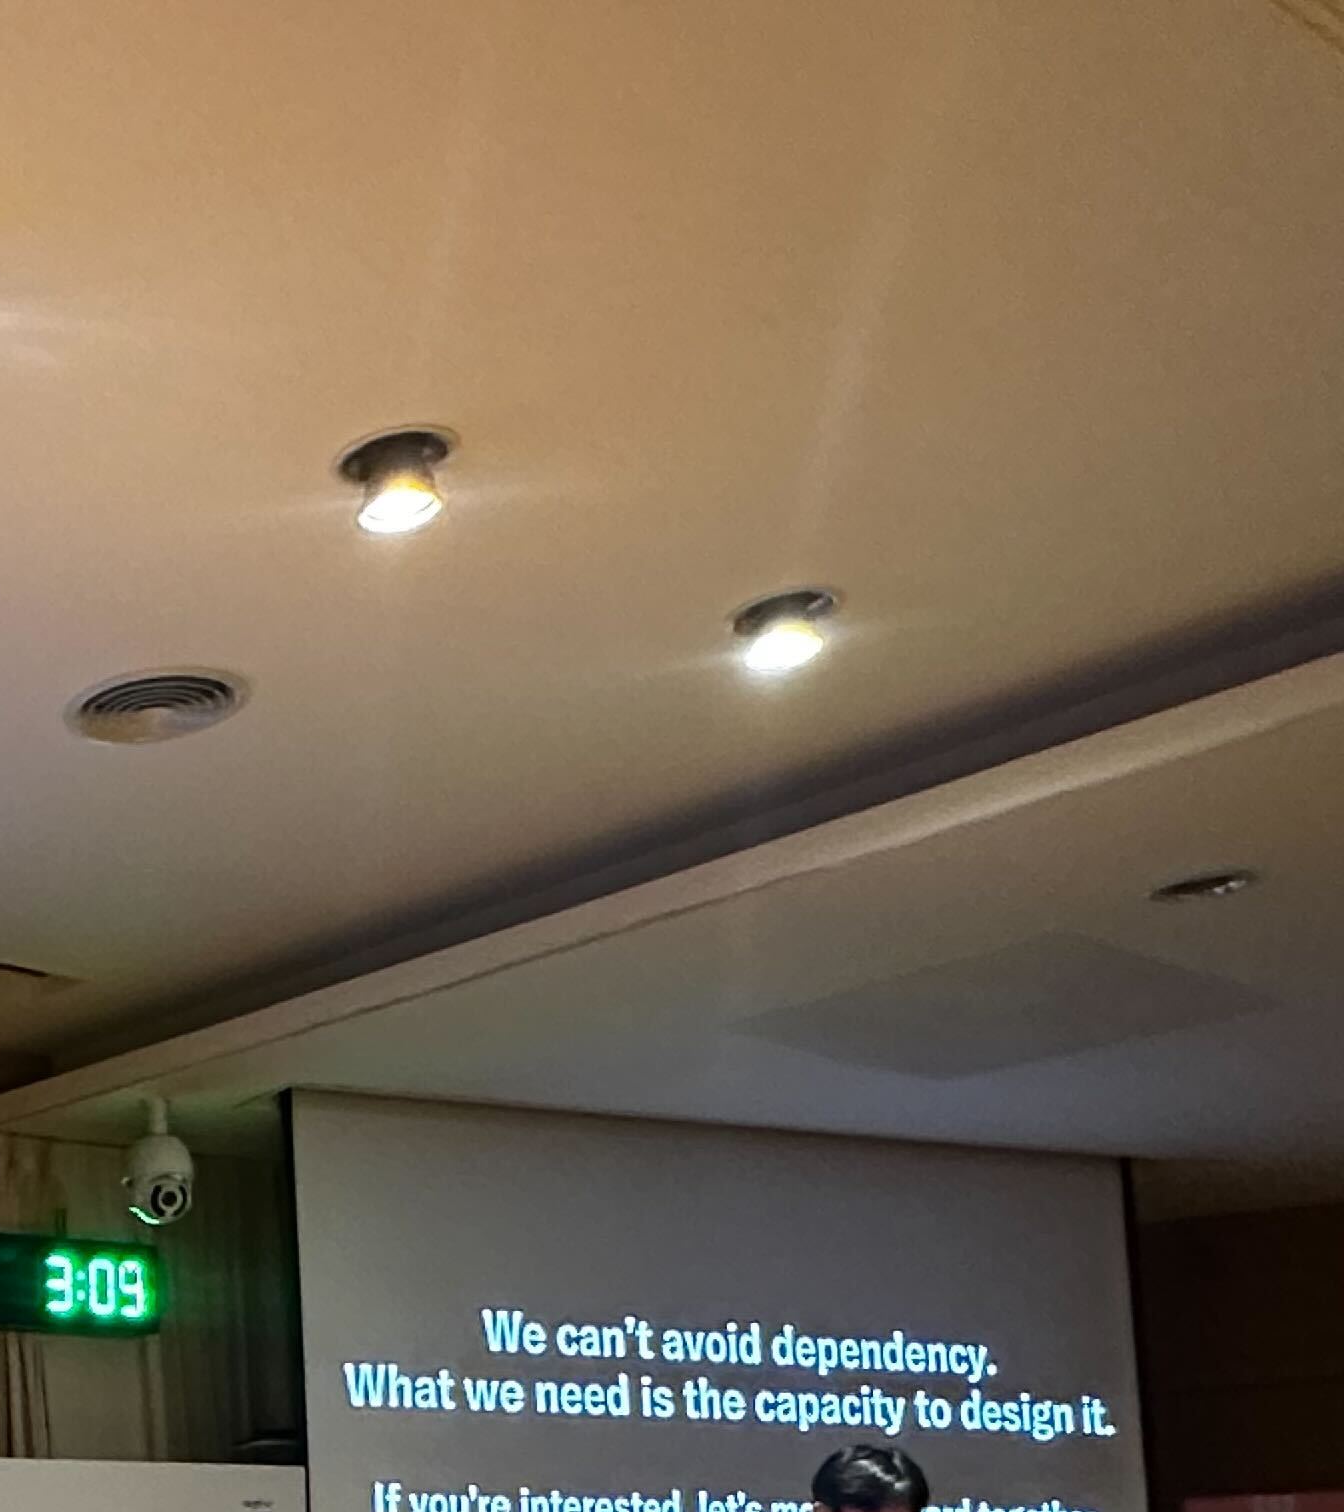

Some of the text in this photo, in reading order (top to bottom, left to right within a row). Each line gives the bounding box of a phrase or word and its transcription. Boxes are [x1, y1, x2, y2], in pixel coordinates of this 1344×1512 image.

[45, 1254, 146, 1318] 3:09
[481, 1308, 548, 1355] We
[661, 1322, 762, 1366] avoid
[770, 1324, 998, 1384] dependency.
[342, 1362, 1117, 1442] What we need is the capacity to design it.
